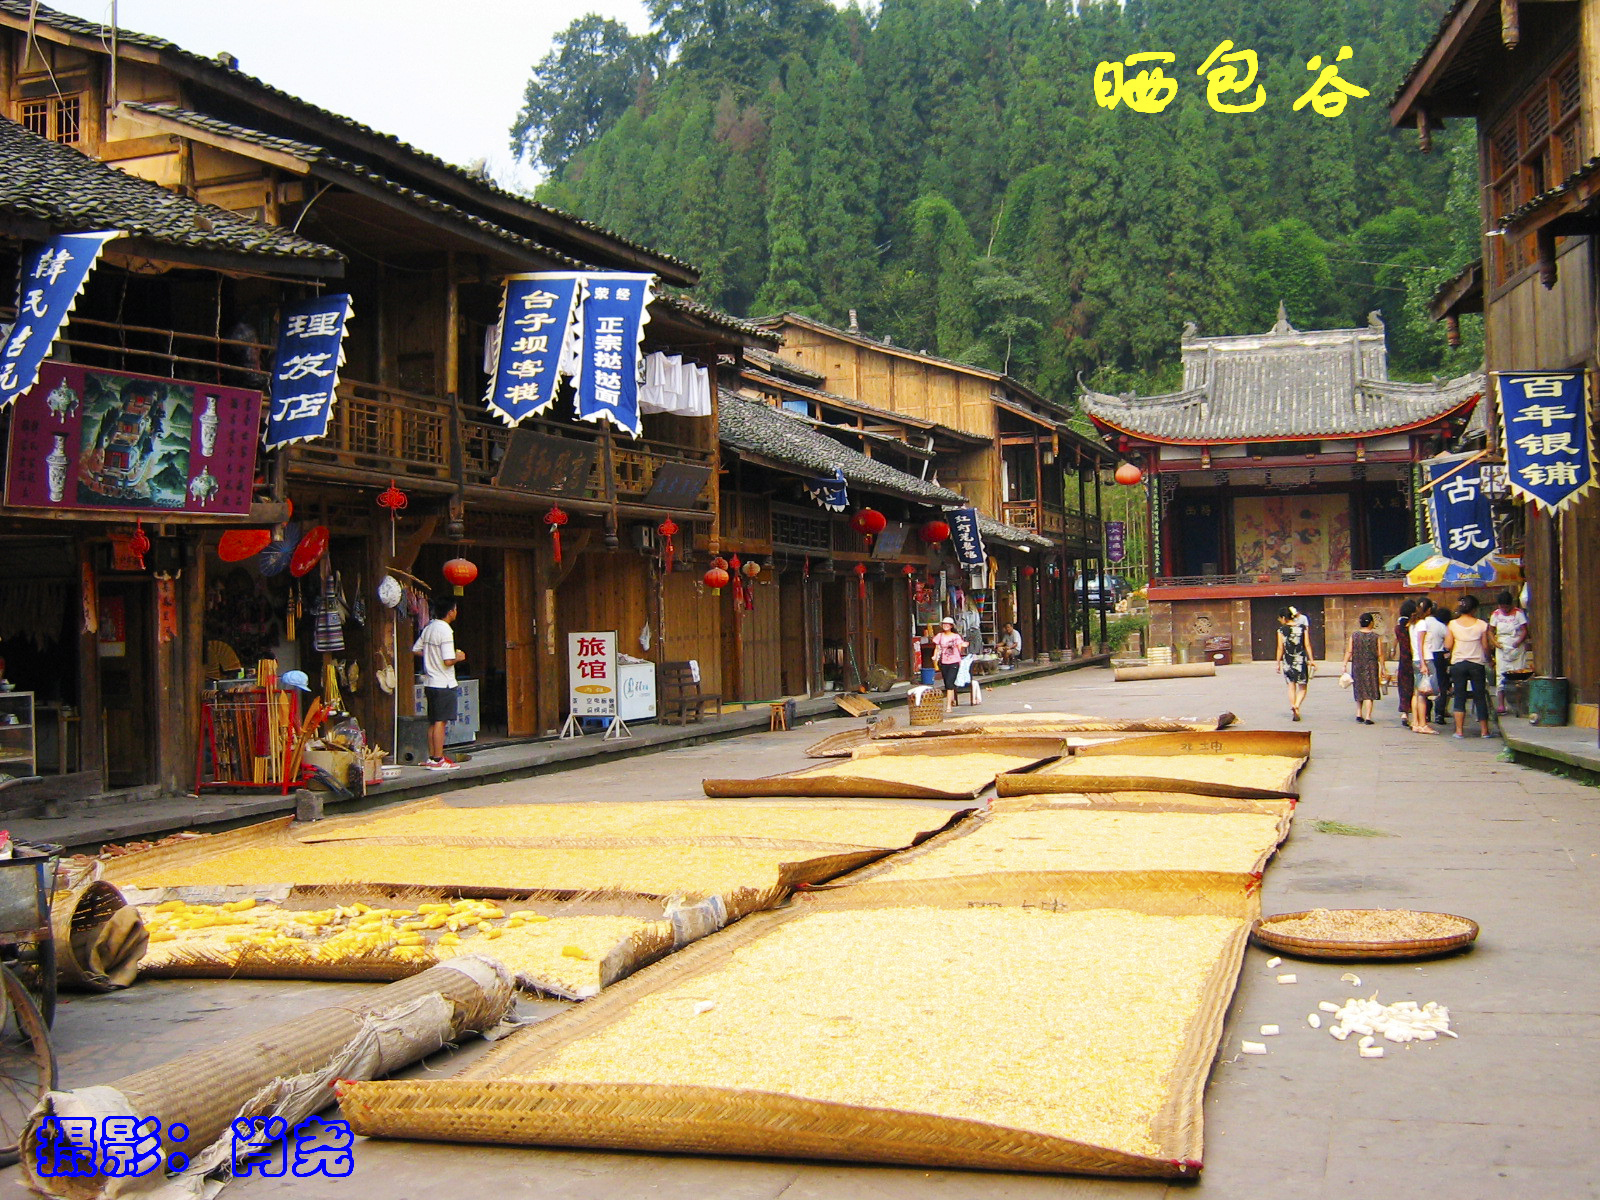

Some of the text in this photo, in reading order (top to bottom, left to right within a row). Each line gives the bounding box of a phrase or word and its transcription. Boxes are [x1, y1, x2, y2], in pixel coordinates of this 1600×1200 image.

[594, 287, 631, 301] 荥经
[272, 311, 340, 421] 理发店
[593, 317, 624, 406] 正宗挞挞面
[1509, 375, 1580, 486] 百年银铺
[1441, 476, 1489, 551] 古玩
[576, 636, 607, 679] 旅馆
